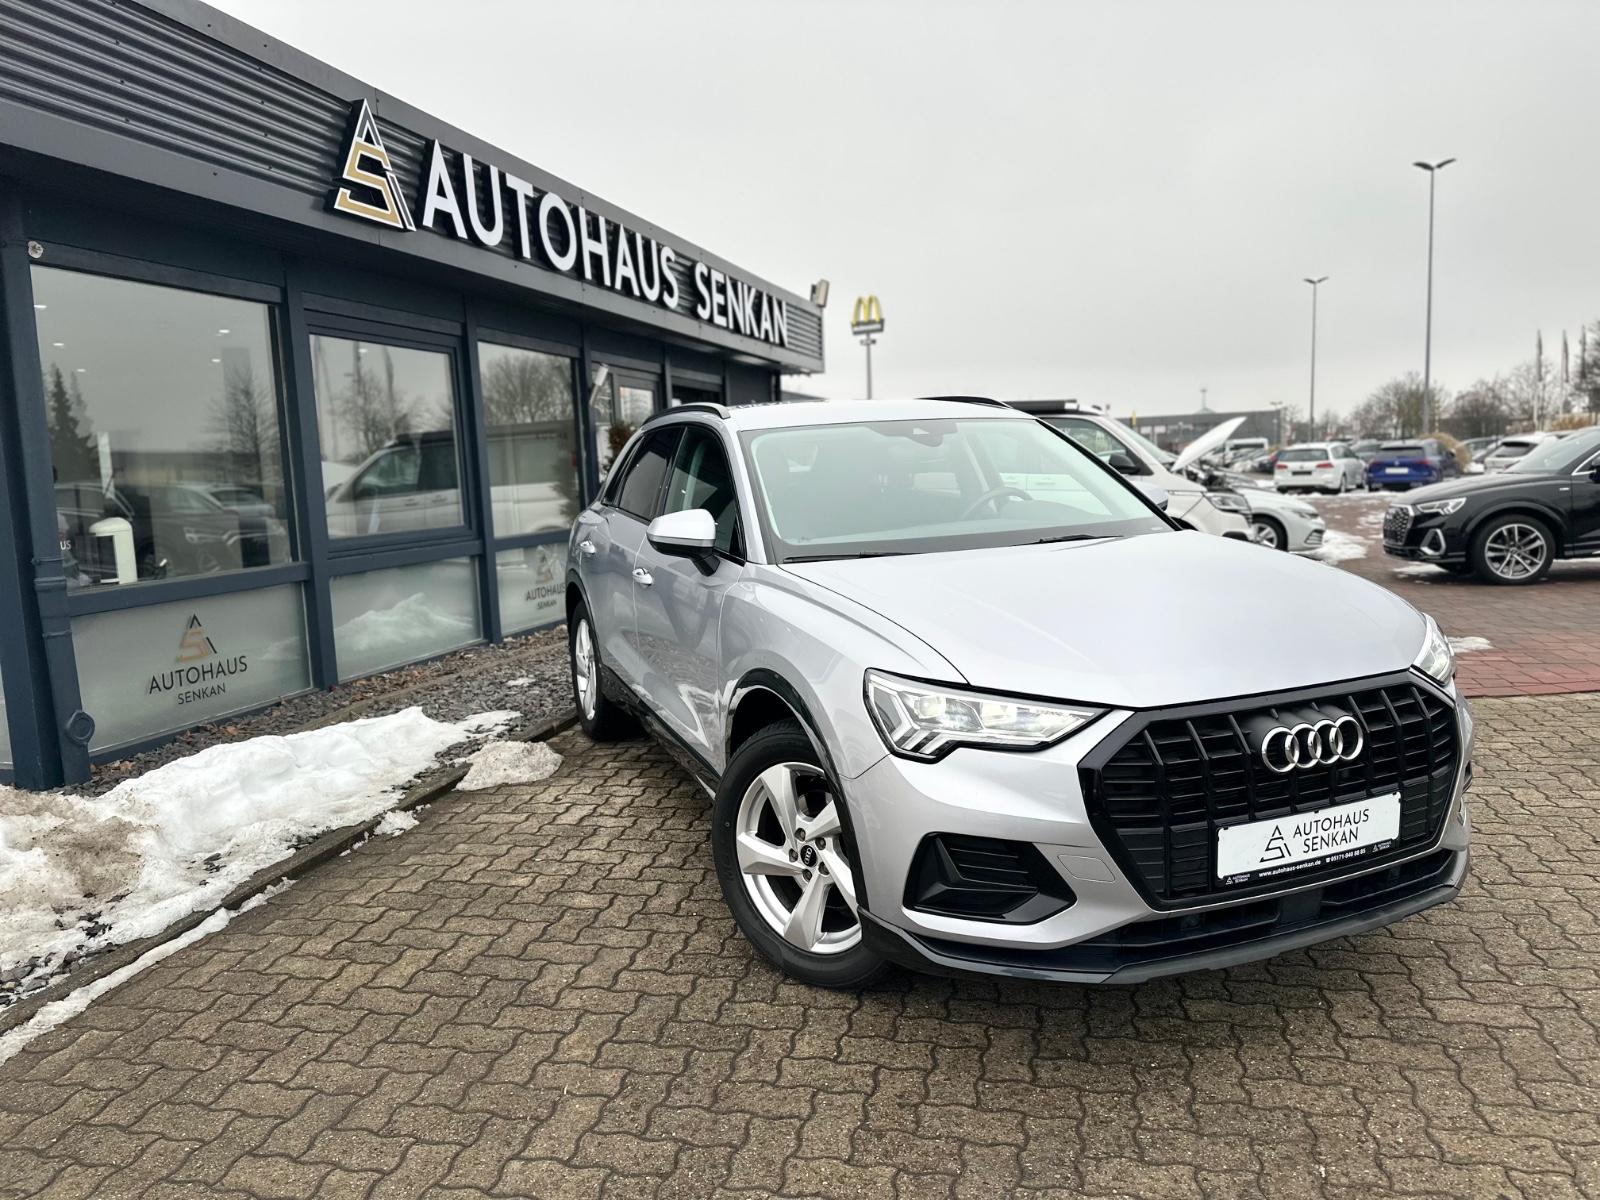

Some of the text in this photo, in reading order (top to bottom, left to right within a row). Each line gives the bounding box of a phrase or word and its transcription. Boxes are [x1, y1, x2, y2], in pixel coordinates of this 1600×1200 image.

[422, 138, 788, 348] AUTOHAUS SENKAN
[149, 655, 248, 695] AUTOHAUS
[178, 682, 226, 705] SENKAN
[1293, 808, 1371, 839] AUTOHAUS
[1302, 826, 1359, 854] SENKAN
[1258, 859, 1322, 878] www.autohaus-senkan.de
